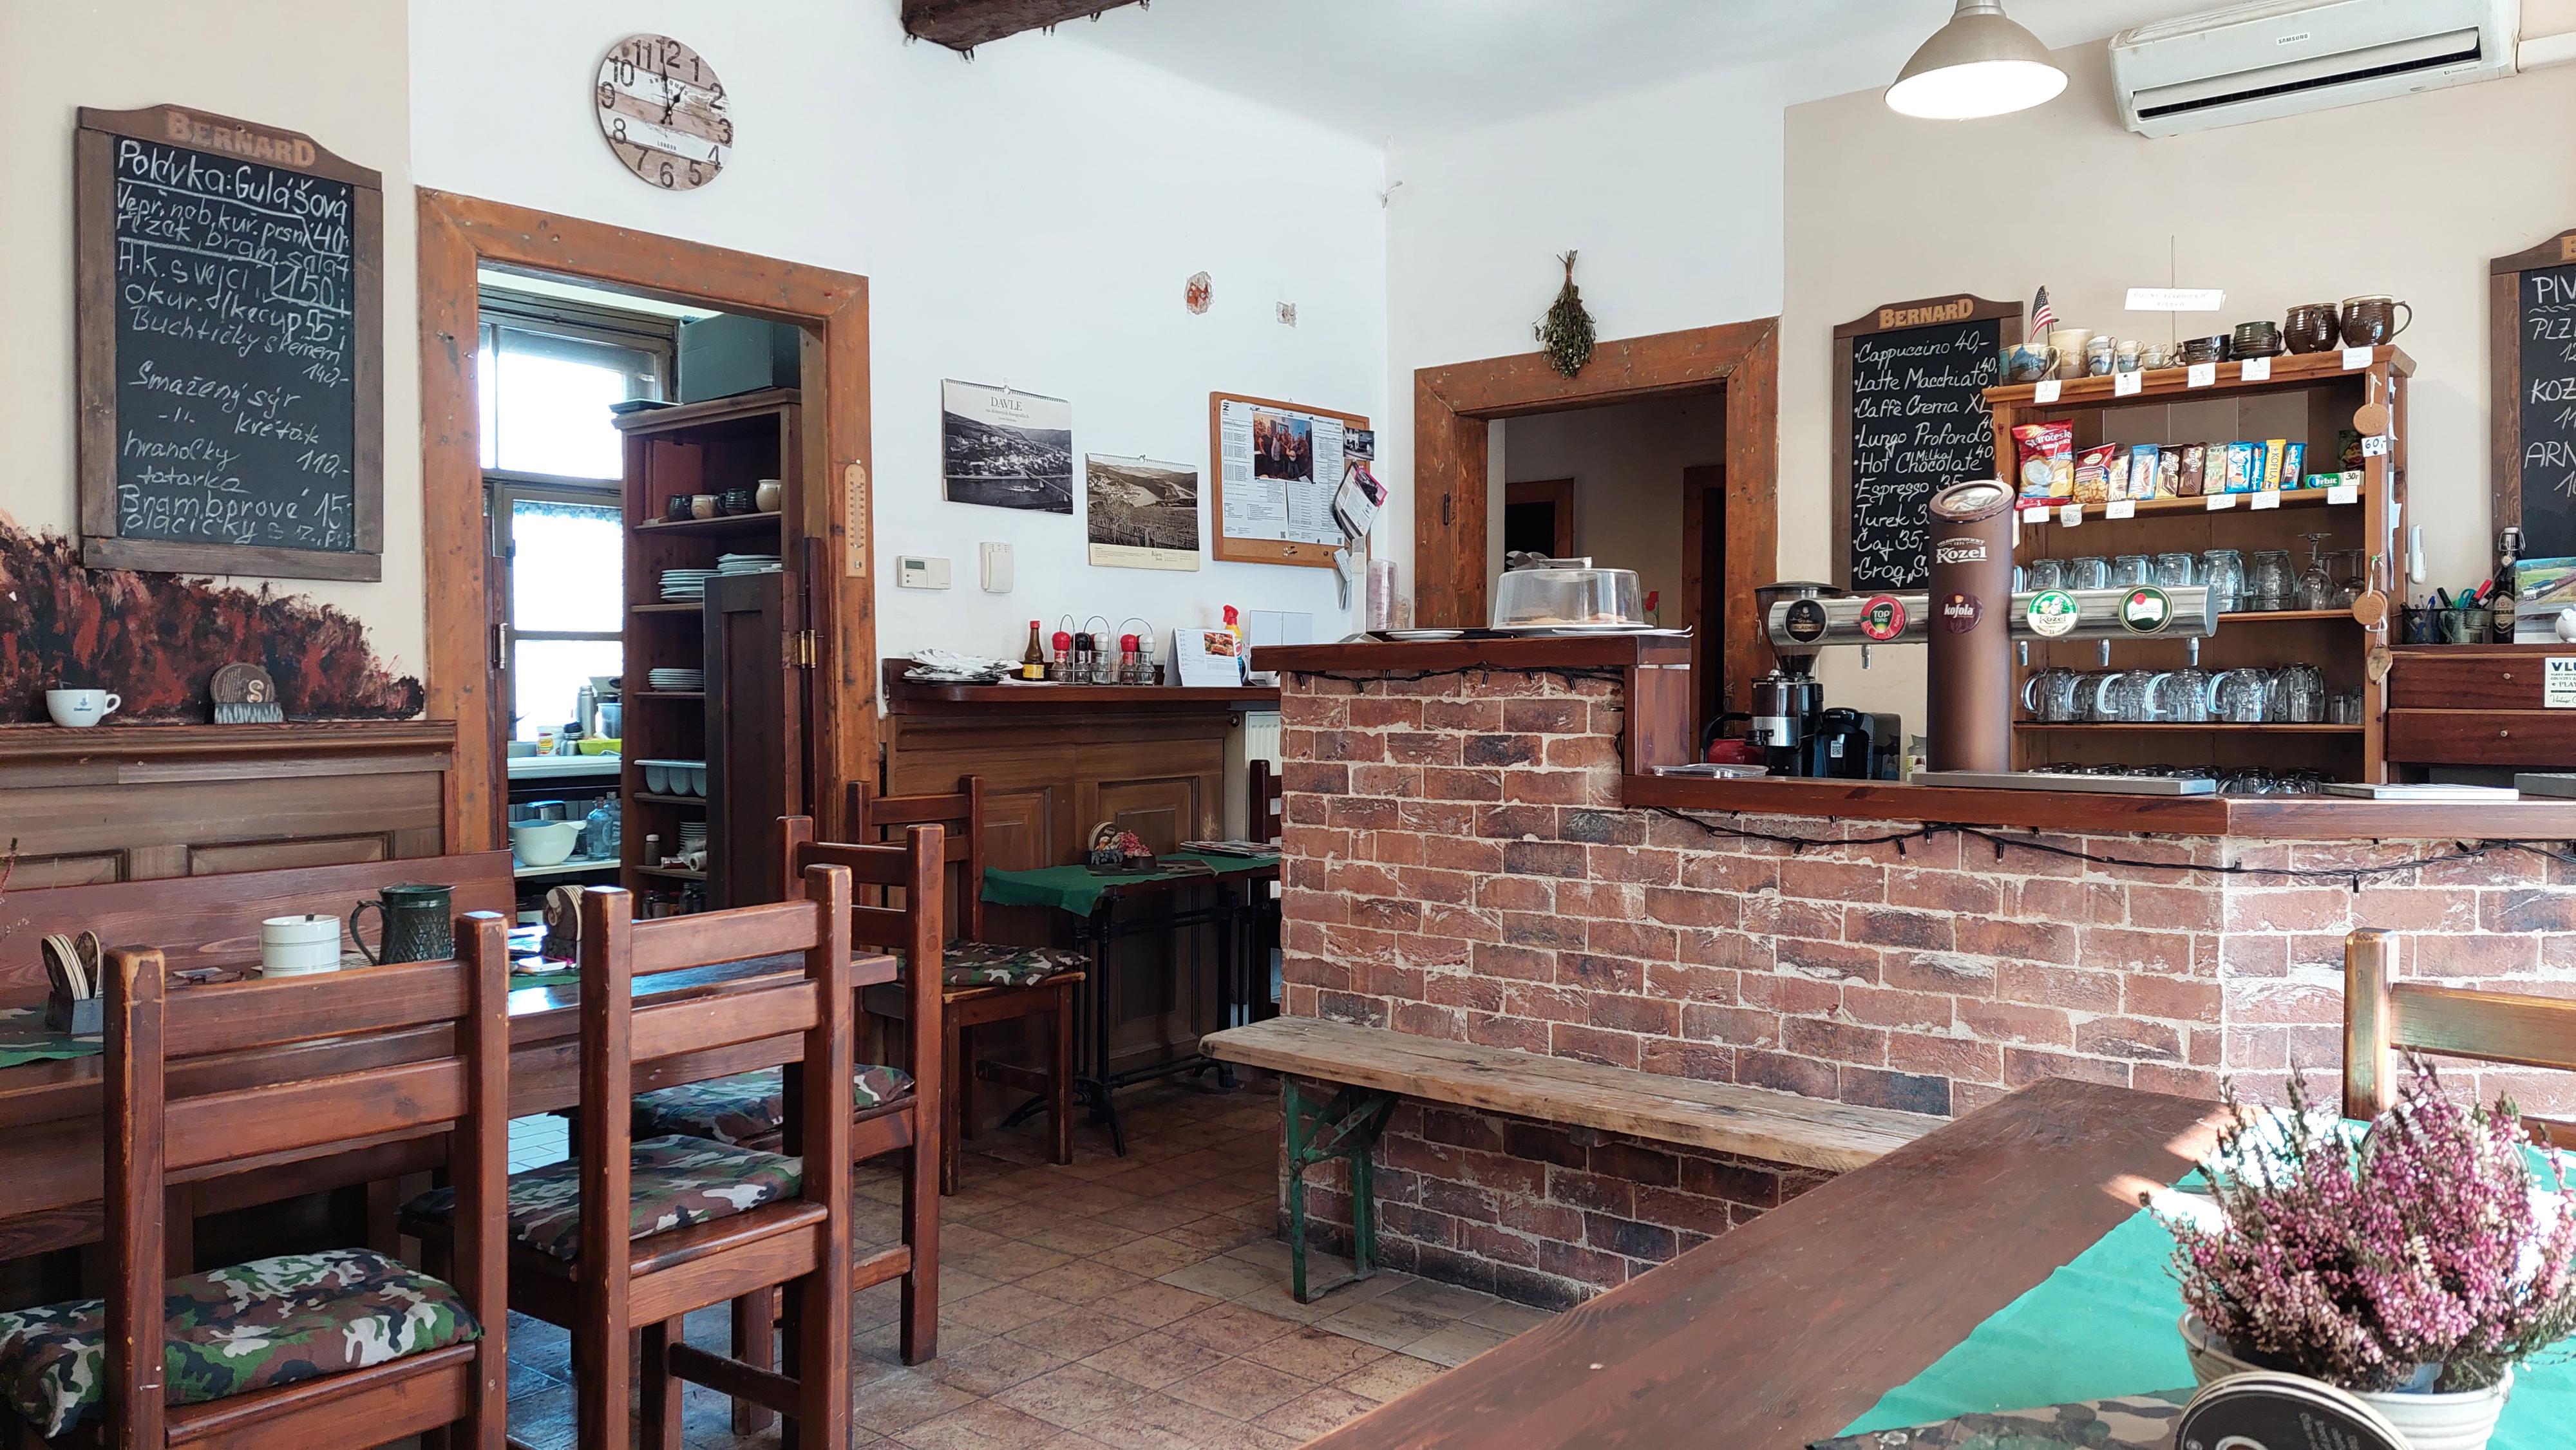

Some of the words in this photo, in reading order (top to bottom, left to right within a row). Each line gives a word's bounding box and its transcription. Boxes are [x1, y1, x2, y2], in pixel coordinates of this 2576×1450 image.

[2278, 33, 2308, 44] SAMSUNG
[632, 39, 652, 70] 11
[656, 37, 681, 70] 12
[608, 55, 634, 88] 10
[690, 55, 700, 82] 1
[600, 80, 616, 109] 9
[708, 82, 724, 110] 2
[165, 109, 316, 169] BERNARD
[612, 117, 627, 145] 8
[717, 117, 732, 146] 3
[634, 144, 649, 171] 7
[707, 144, 721, 171] 4
[659, 161, 674, 188] 6
[688, 160, 702, 186] 5
[1878, 297, 1975, 330] BERNARD
[1857, 341, 1951, 370] Cappuccino
[1856, 369, 1901, 393] Latte
[1904, 361, 1989, 390] Macchiato
[990, 396, 1023, 411] DAVLE
[1857, 397, 1902, 419] Caffè
[1906, 394, 1960, 417] Crema
[1964, 392, 1994, 415] XL
[1858, 424, 1907, 458] Lungo
[1914, 419, 1993, 447] Profondo
[2024, 429, 2072, 448] Staročesk
[1860, 452, 1889, 475] Hot
[1895, 447, 1983, 474] Chocolate
[2269, 452, 2279, 480] KOFILA
[1855, 476, 1929, 505] Espresso
[2310, 476, 2338, 487] Orbit
[1857, 504, 1911, 528] Turek
[1855, 527, 1894, 562] Čaj
[1936, 546, 1988, 564] Kozel
[1858, 556, 1906, 587] Grog
[1873, 610, 1891, 618] TOP
[1944, 603, 1975, 619] kofola
[2039, 616, 2067, 624] Kozel
